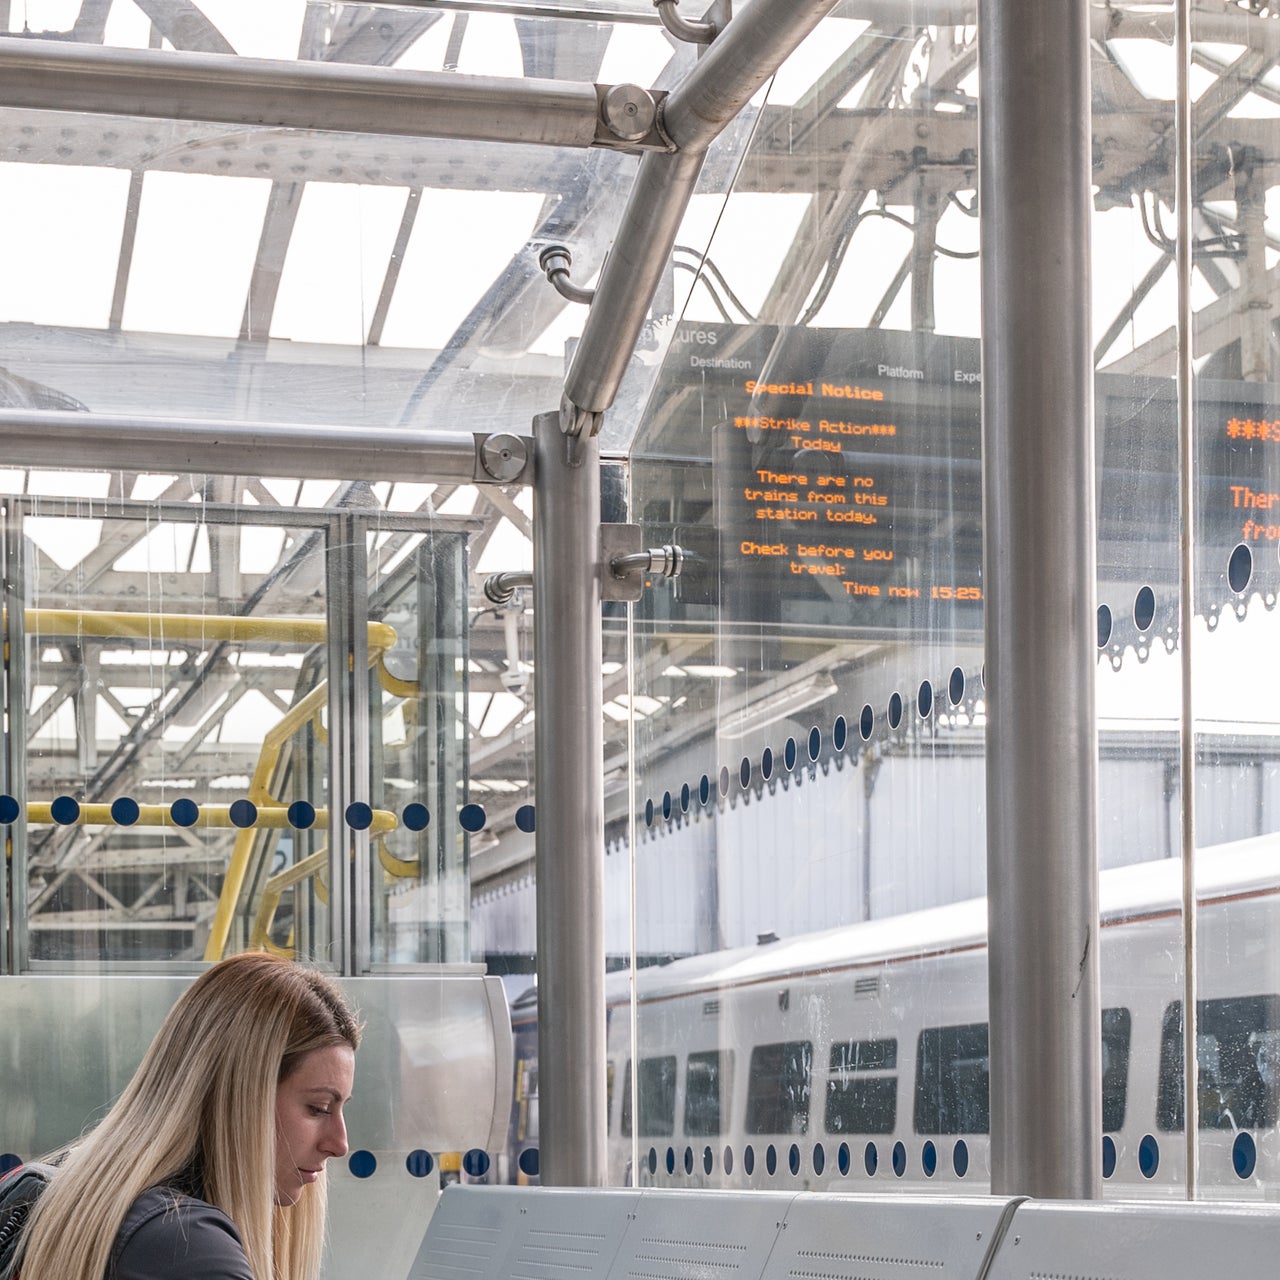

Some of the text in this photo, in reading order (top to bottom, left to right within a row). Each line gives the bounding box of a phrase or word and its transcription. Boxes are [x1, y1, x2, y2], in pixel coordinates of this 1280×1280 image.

[690, 355, 752, 369] Destination
[878, 364, 924, 380] Platform
[745, 380, 884, 401] Special Notice
[791, 436, 842, 453] Today
[756, 469, 874, 488] There are no
[744, 488, 887, 506] trains from this
[756, 507, 878, 525] station today.
[740, 541, 893, 561] Check before you
[790, 562, 845, 576] travel:
[842, 581, 880, 596] Time
[888, 586, 919, 597] now
